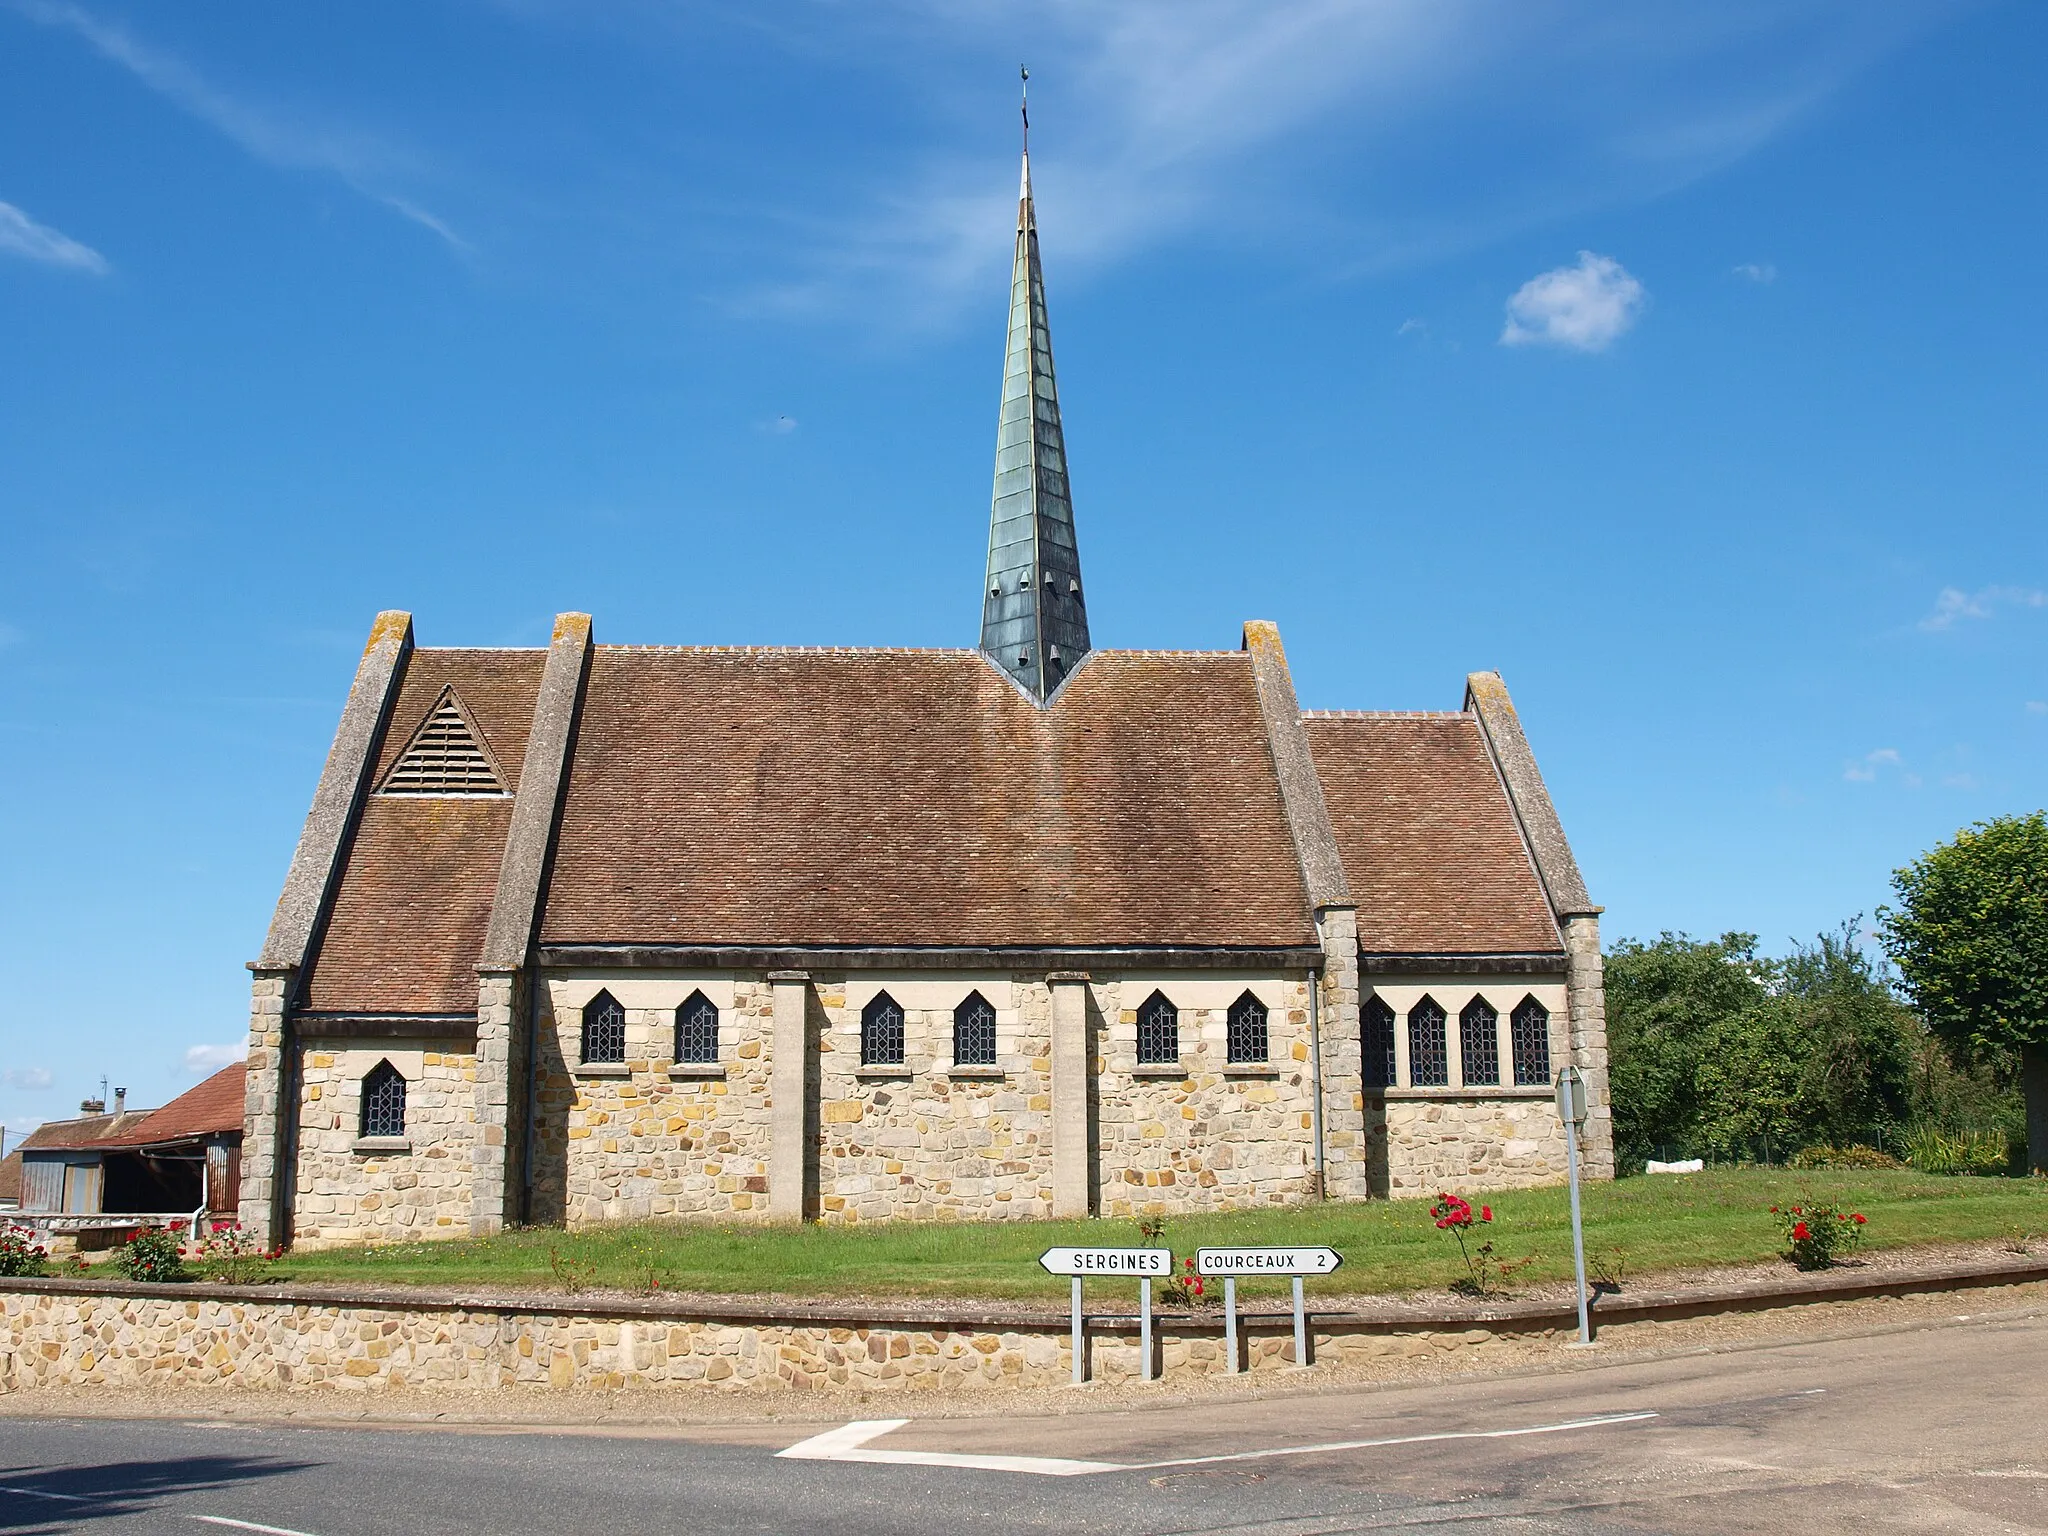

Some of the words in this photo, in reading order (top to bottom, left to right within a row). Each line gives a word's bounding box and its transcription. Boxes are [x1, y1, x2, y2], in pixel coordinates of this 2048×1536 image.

[1073, 1253, 1160, 1270] SERGINES
[1204, 1255, 1295, 1268] COURCEAUX
[1317, 1254, 1326, 1267] 2
